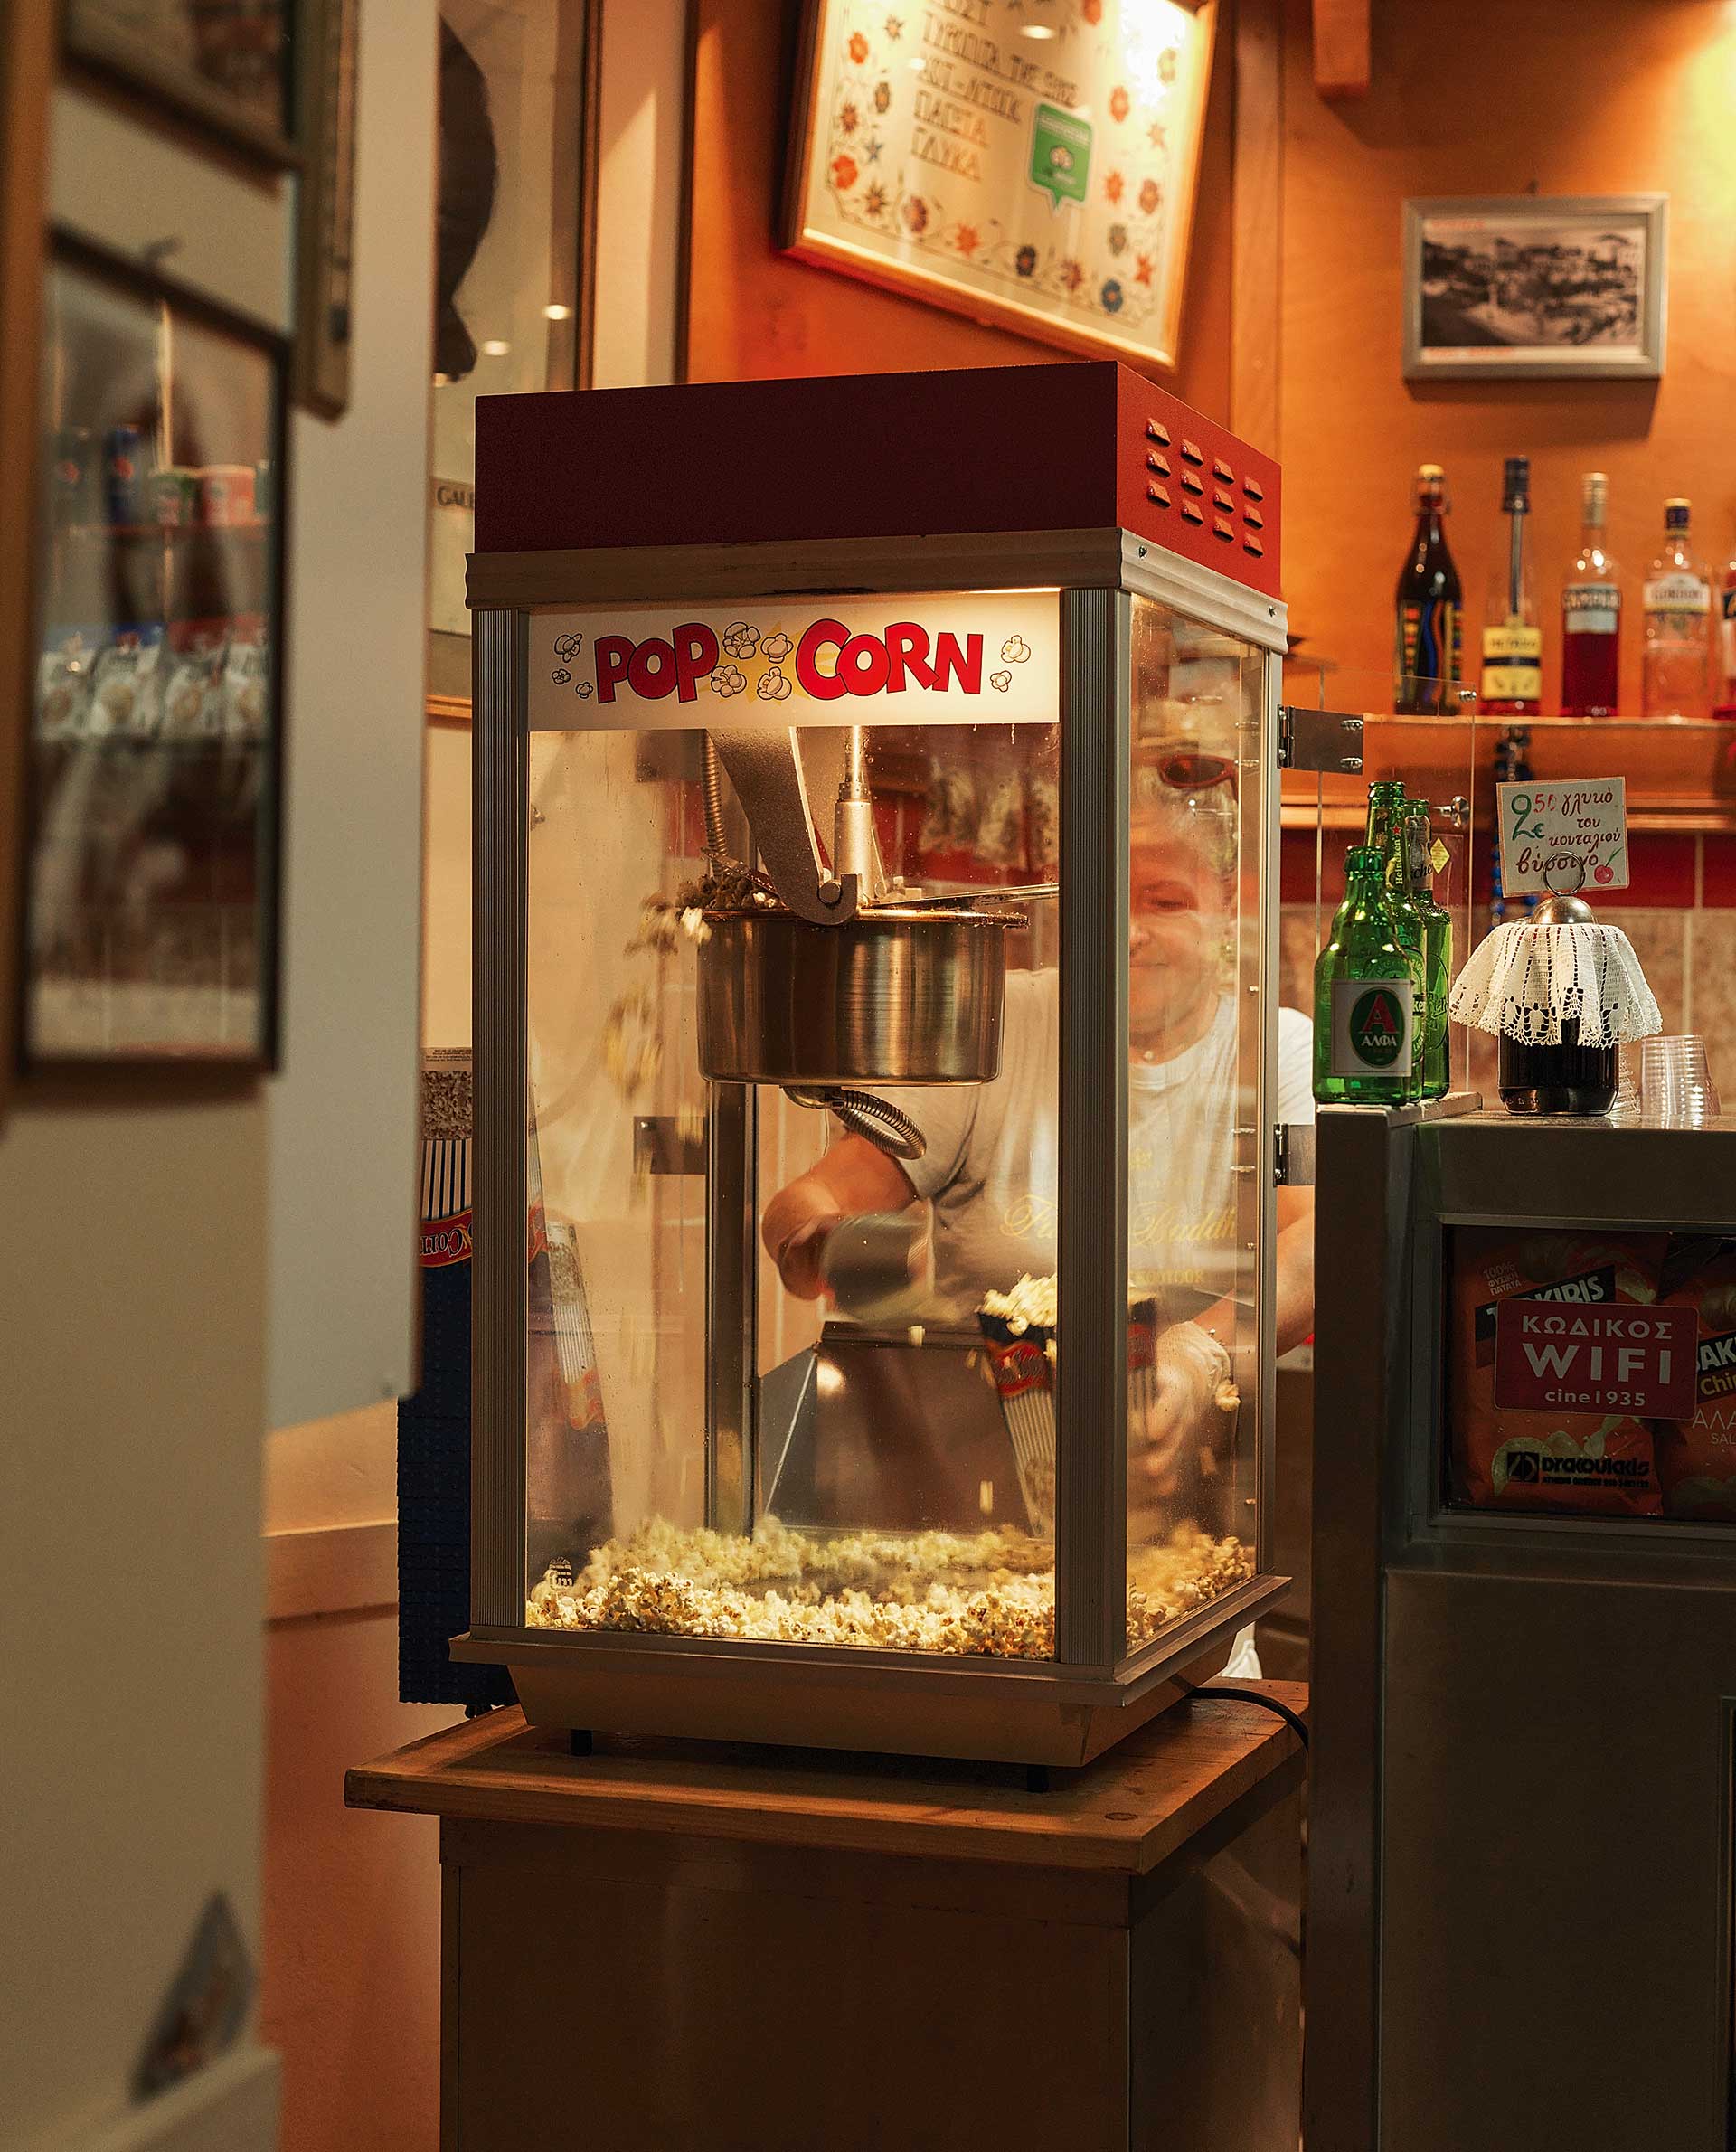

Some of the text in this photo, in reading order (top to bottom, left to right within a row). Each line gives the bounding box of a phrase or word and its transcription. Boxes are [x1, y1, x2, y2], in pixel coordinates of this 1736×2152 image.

[594, 618, 984, 703] POP CORN
[1577, 817, 1601, 828] του
[1549, 827, 1621, 853] κουταλιού
[1523, 1315, 1672, 1340] ΚΩΔΙΚΟΣ
[1522, 1343, 1671, 1384] WIFI
